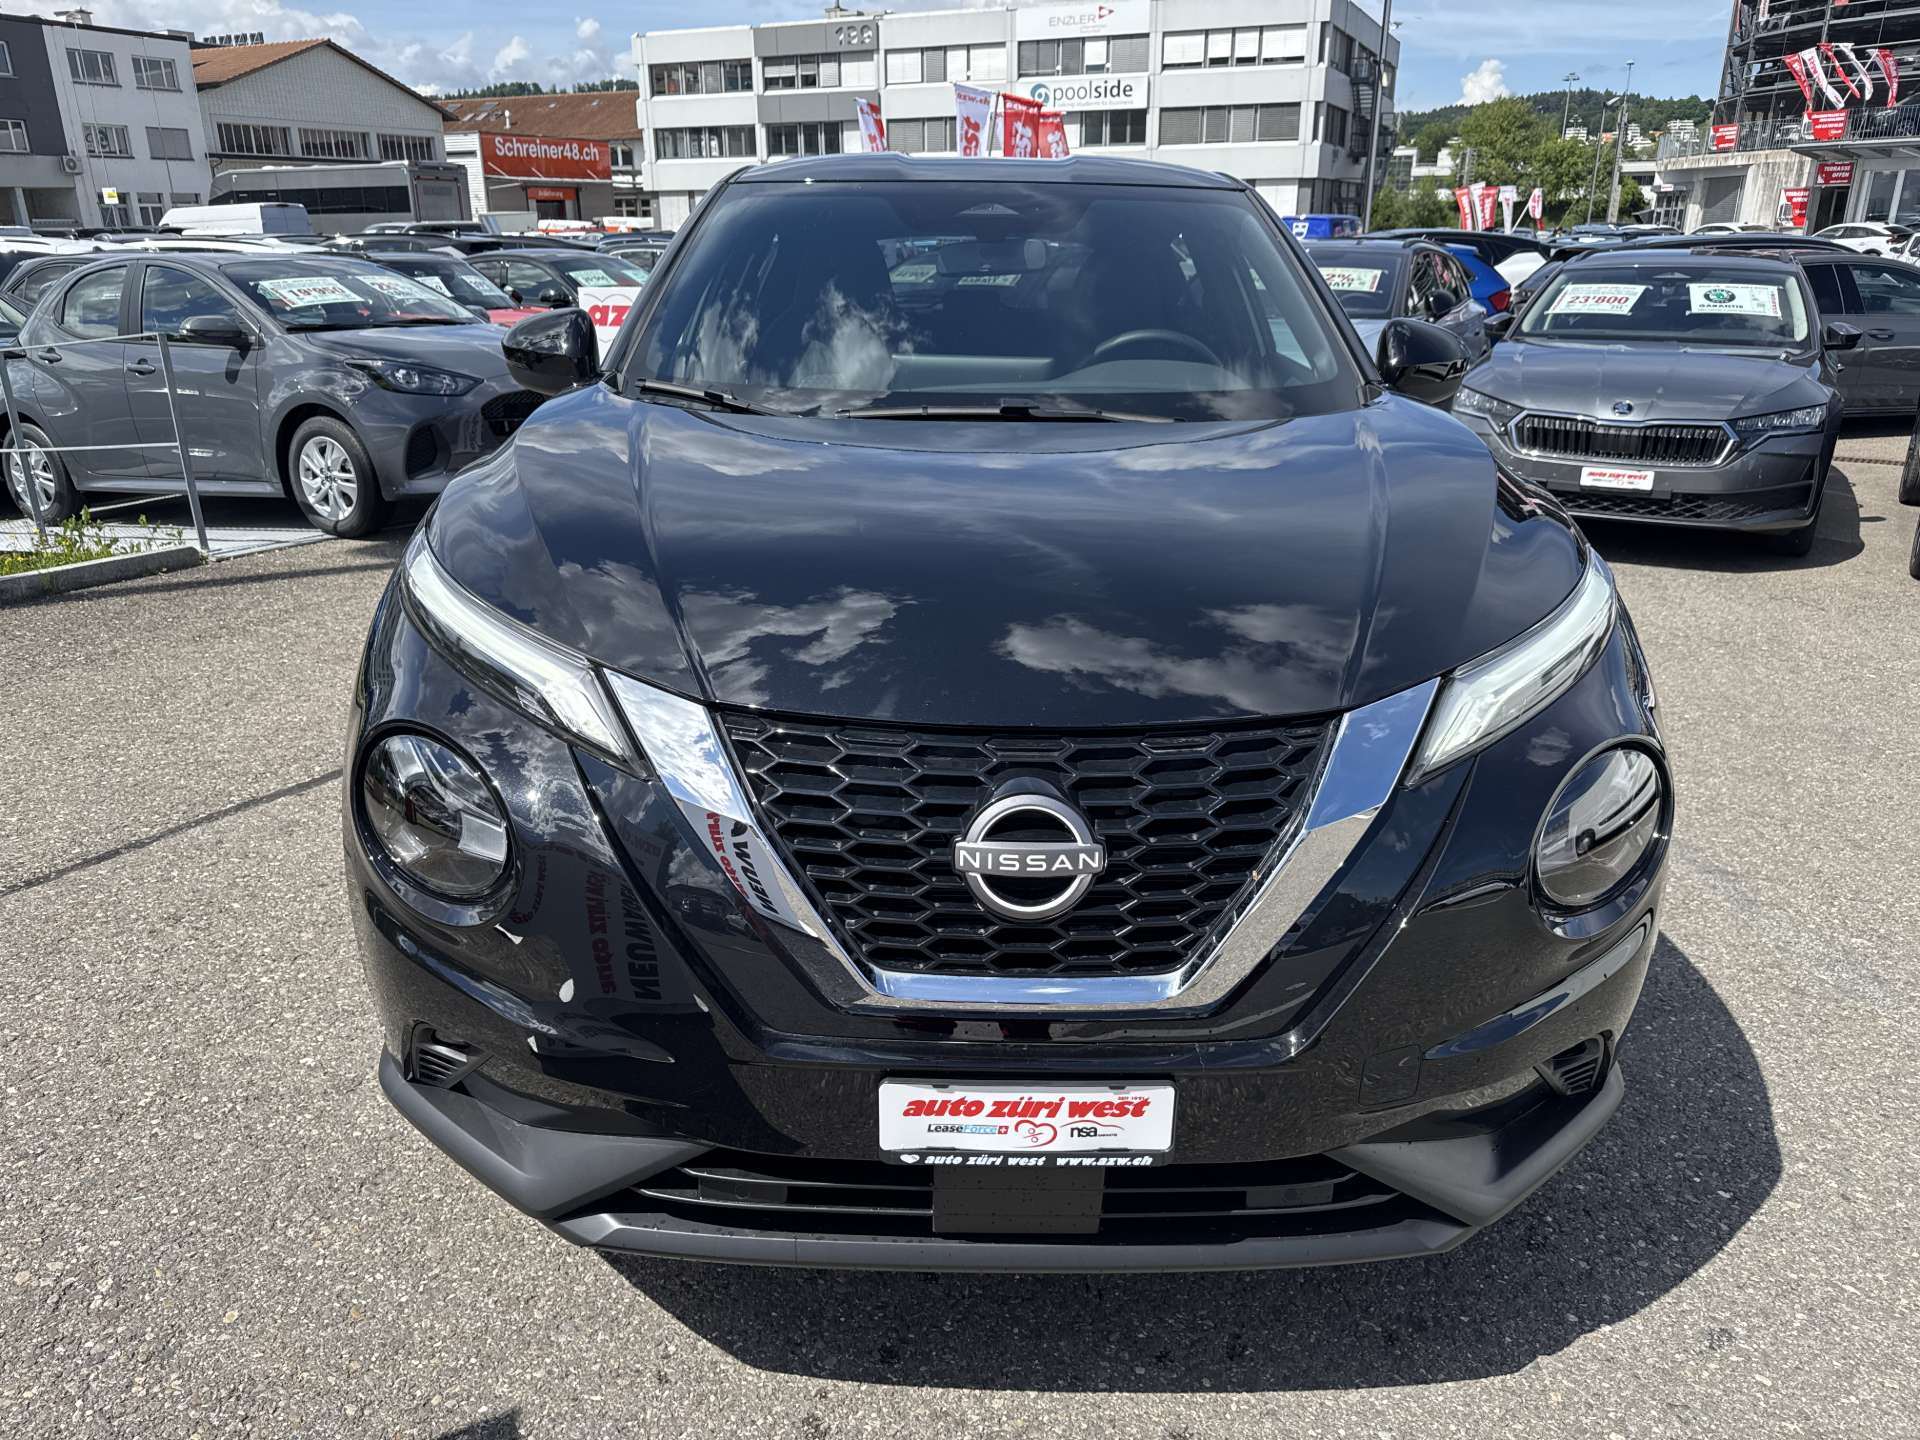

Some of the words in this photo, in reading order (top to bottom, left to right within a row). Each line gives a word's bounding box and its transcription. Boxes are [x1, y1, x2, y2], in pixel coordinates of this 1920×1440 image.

[1049, 14, 1097, 27] ENZLER
[1053, 79, 1133, 108] poolside
[495, 137, 600, 161] Schreiner48.ch
[1568, 295, 1630, 305] 23'800
[959, 850, 1099, 871] NISSAN
[902, 1096, 985, 1117] auto
[986, 1096, 1066, 1118] züri
[1068, 1097, 1152, 1118] west
[927, 1124, 998, 1134] LeaseForce
[1070, 1127, 1097, 1138] nsa
[924, 1155, 963, 1165] auto
[966, 1154, 1004, 1166] züri
[1007, 1155, 1046, 1166] west
[1056, 1155, 1154, 1166] www.azw.ch
